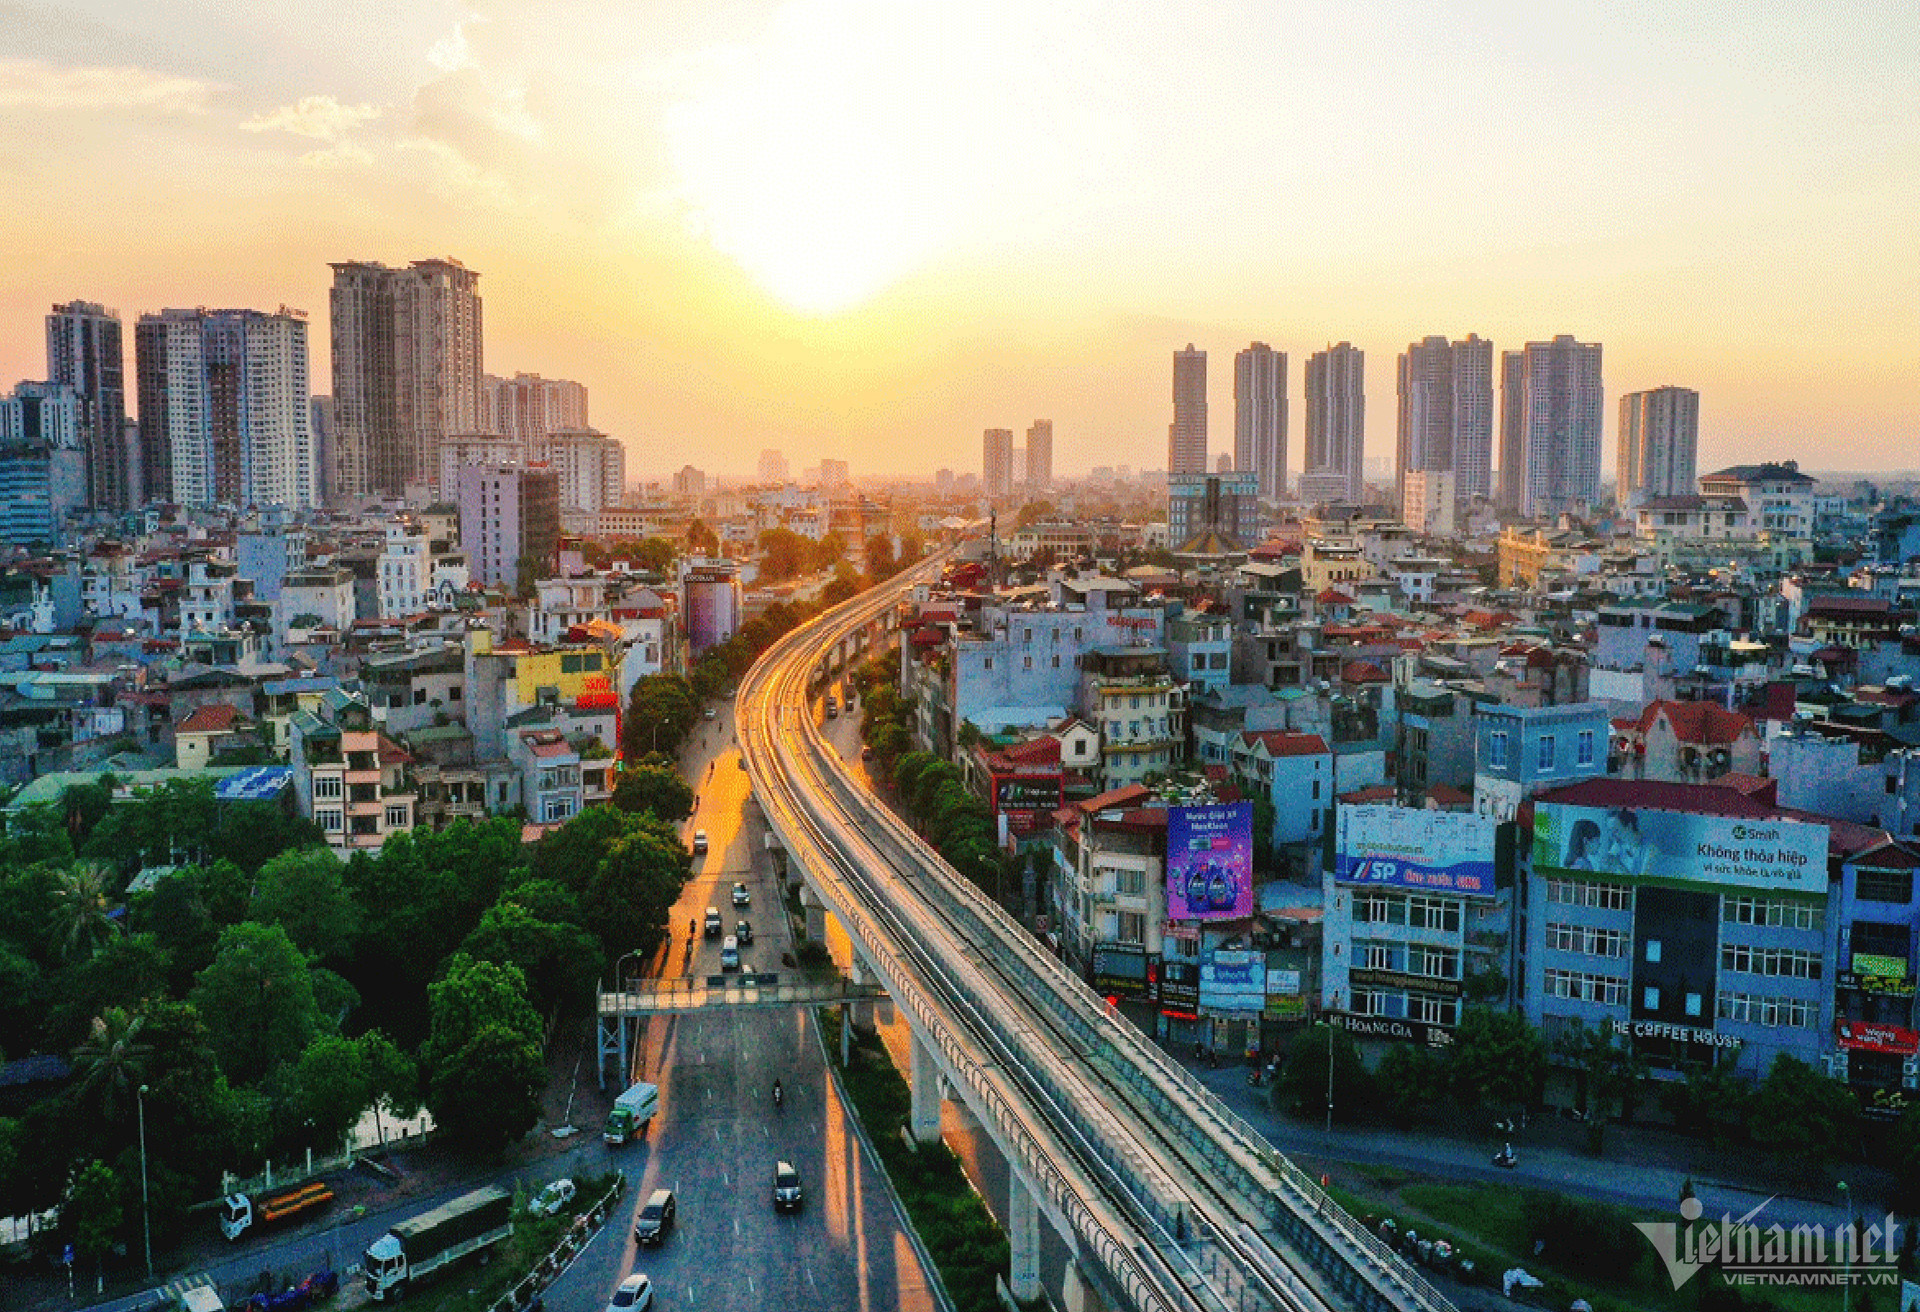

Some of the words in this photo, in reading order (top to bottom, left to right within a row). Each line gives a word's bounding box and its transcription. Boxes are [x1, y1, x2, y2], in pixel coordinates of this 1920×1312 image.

[1697, 842, 1740, 863] Không
[1371, 862, 1397, 880] SP
[1391, 1022, 1413, 1038] GIA
[1612, 1020, 1630, 1034] HE
[1634, 1022, 1689, 1042] COFFEE
